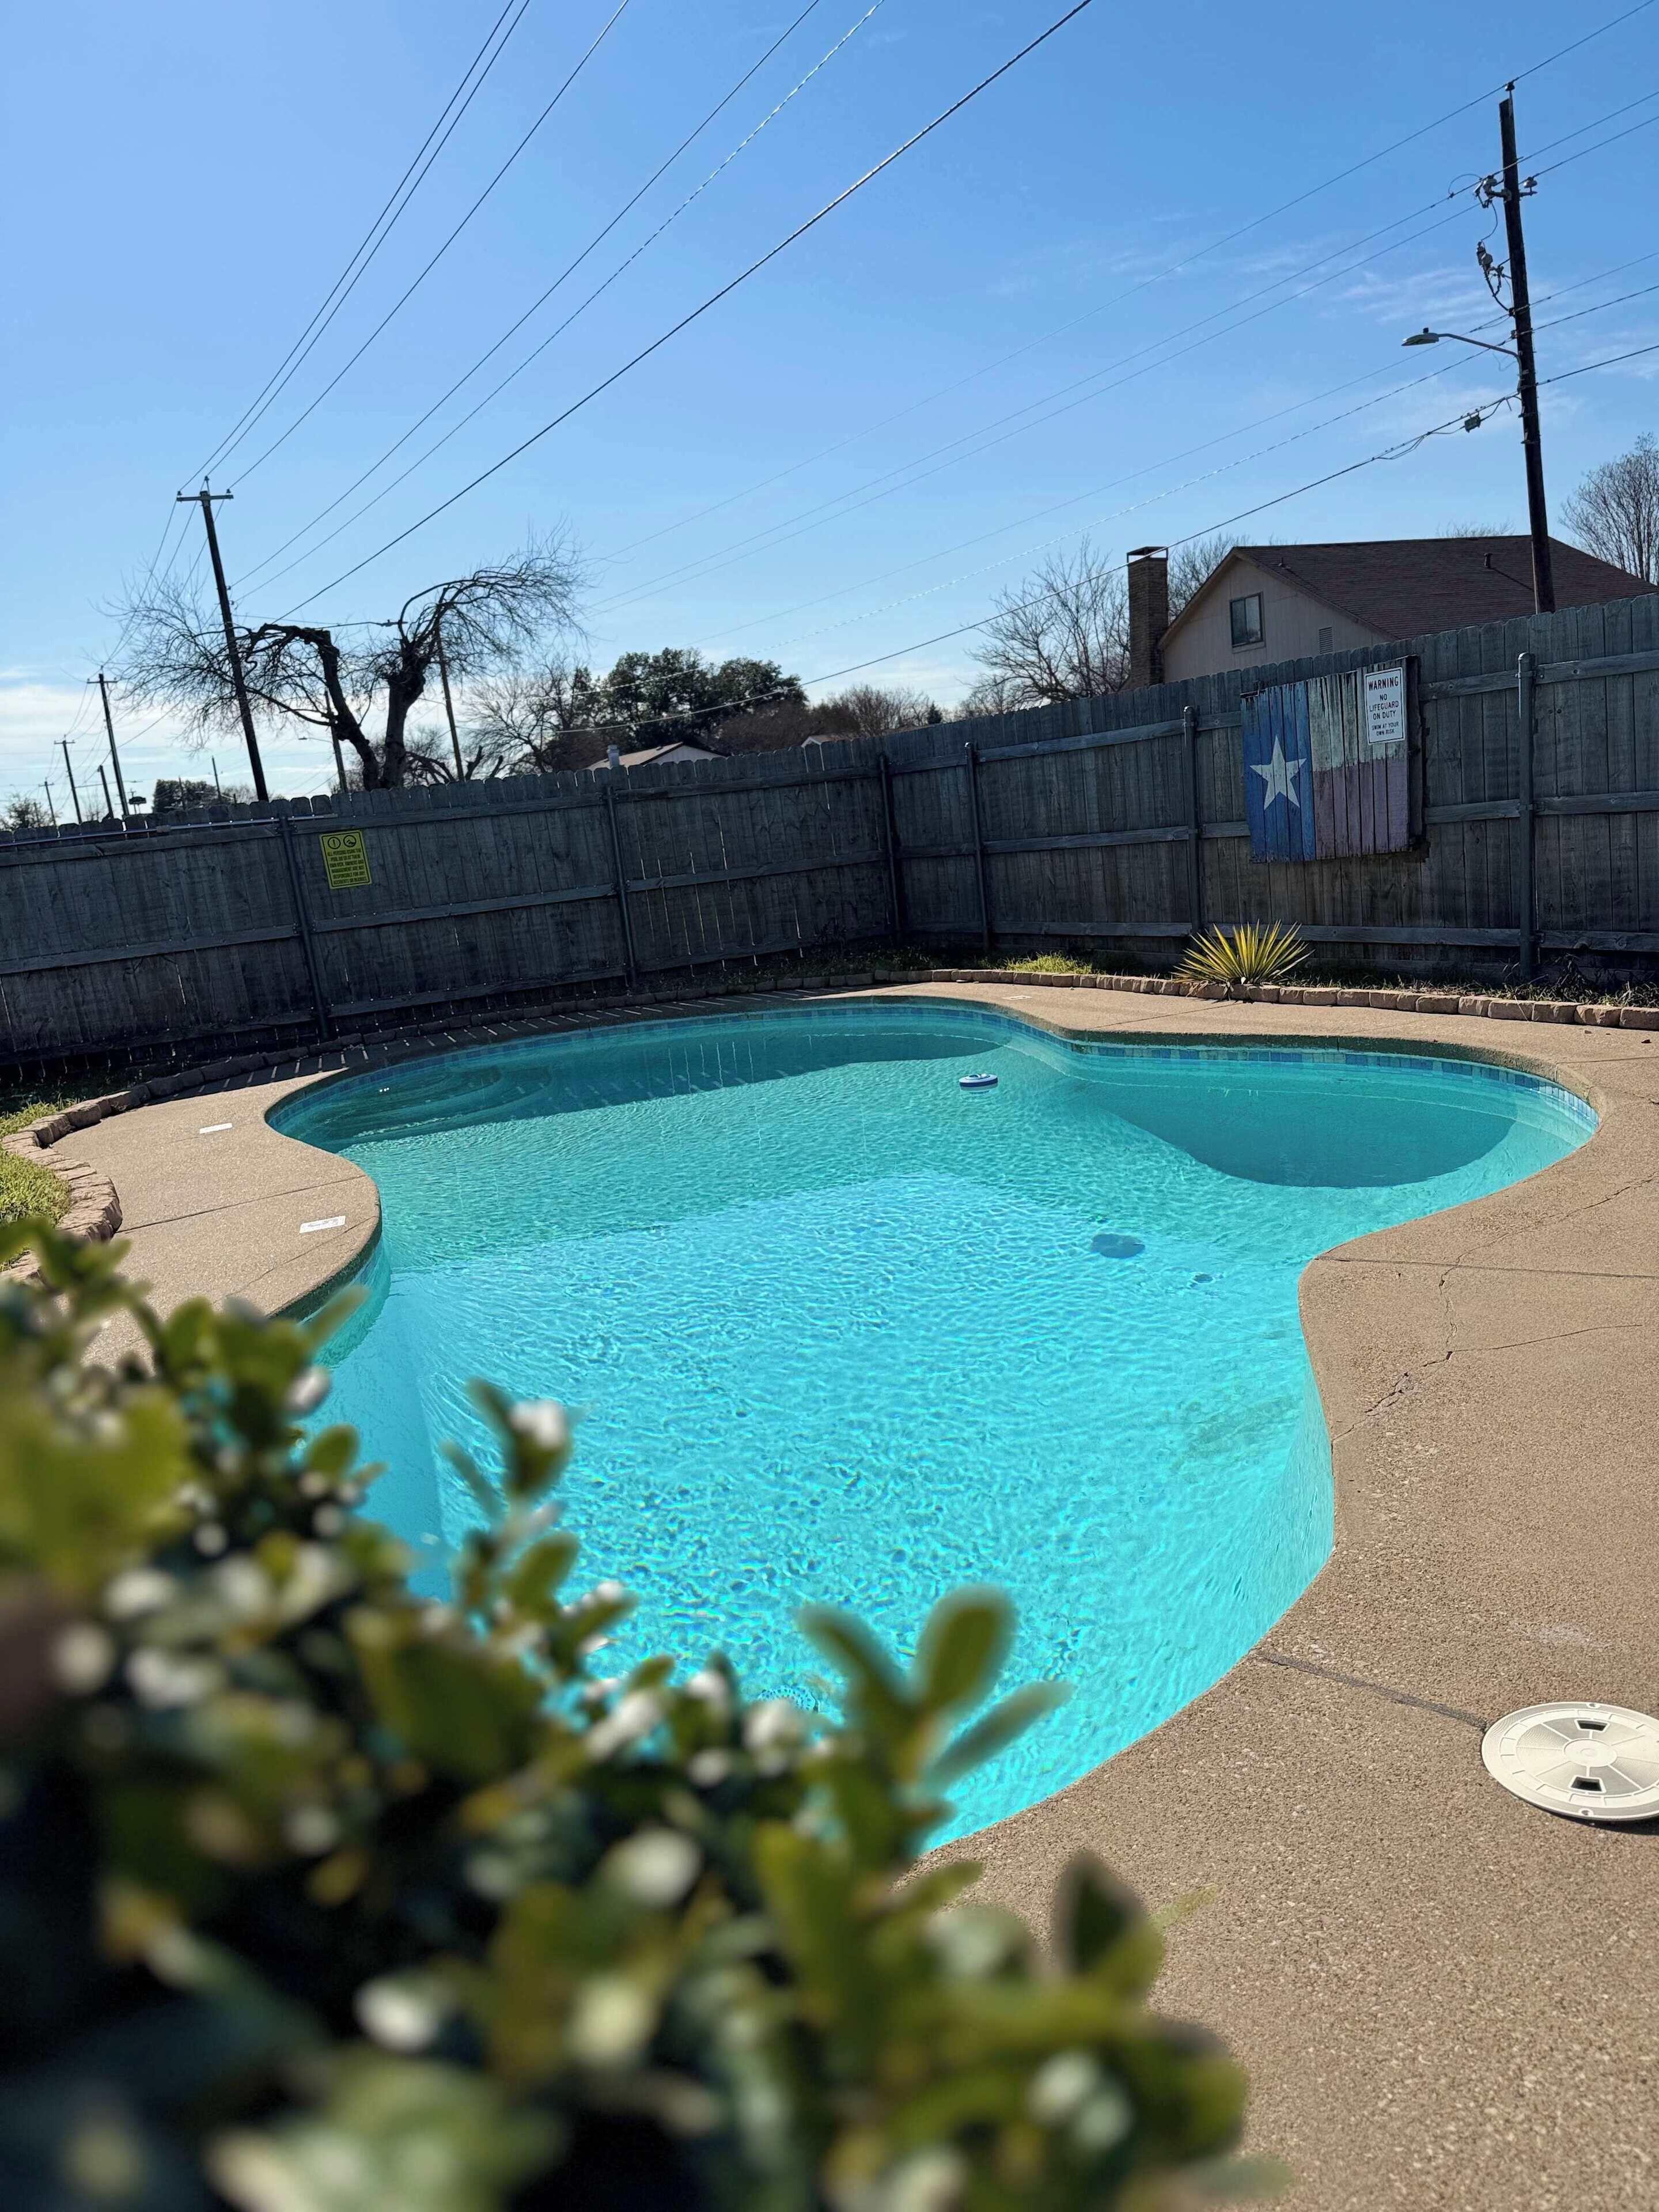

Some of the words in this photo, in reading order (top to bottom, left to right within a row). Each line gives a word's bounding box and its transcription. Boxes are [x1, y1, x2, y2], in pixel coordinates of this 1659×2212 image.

[1369, 676, 1399, 691] WARNING
[1369, 701, 1399, 712] LIFEGUARD
[1382, 710, 1396, 719] DUTY
